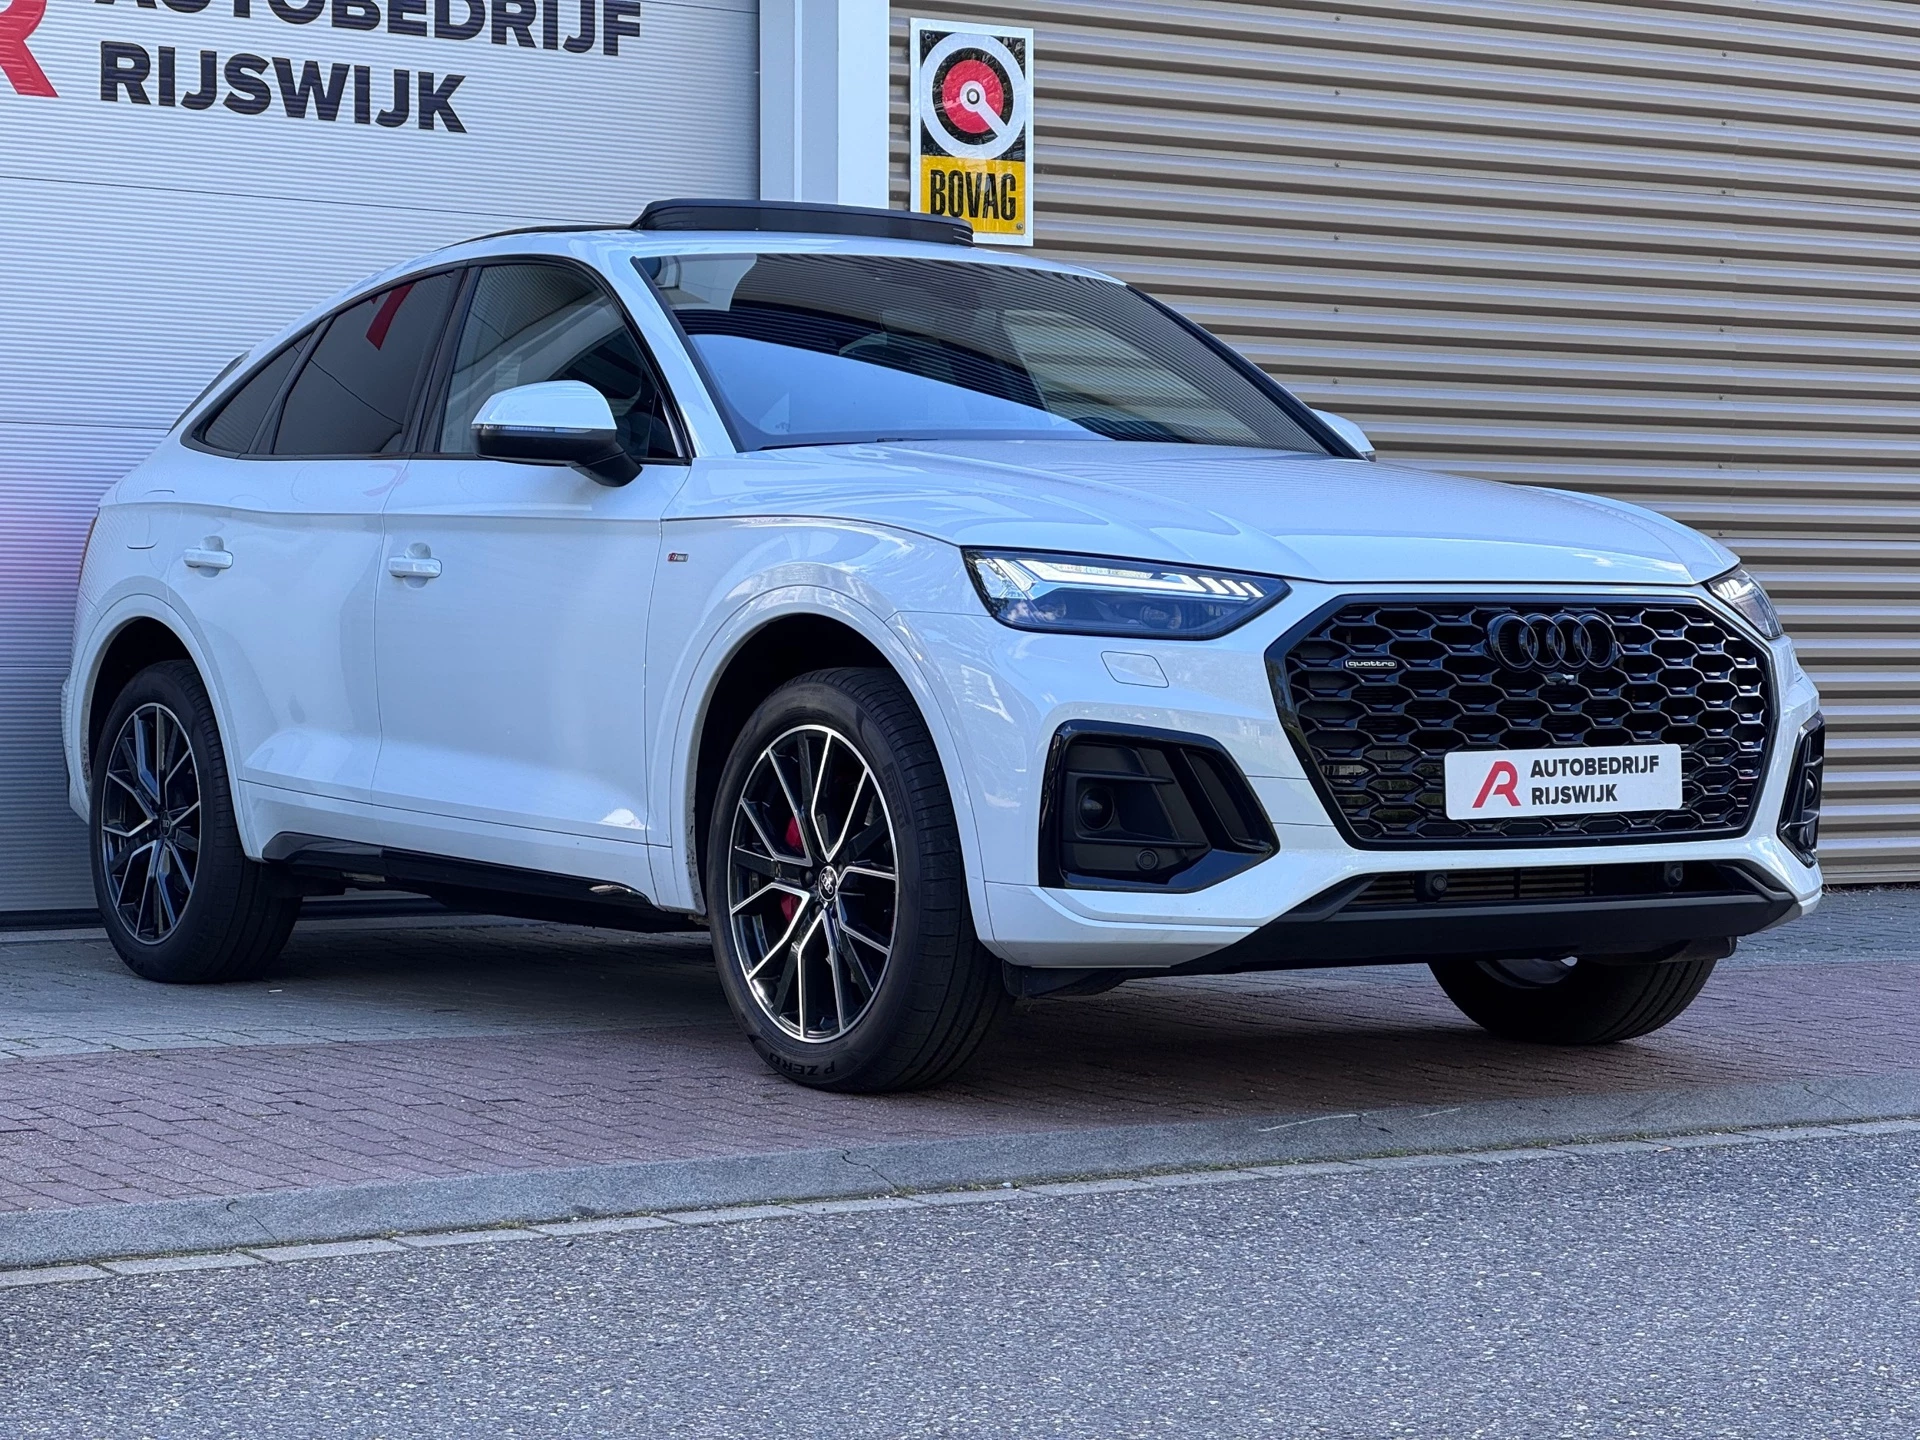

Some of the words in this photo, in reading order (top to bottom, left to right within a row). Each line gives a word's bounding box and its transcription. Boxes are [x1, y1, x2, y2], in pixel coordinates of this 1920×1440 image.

[94, 0, 641, 56] BEDRIJF
[100, 41, 467, 133] RIJSWIJK
[930, 169, 1016, 221] BOVAG
[1348, 660, 1395, 668] quattro
[1530, 755, 1660, 778] AUTOBEDRIJF
[1531, 784, 1618, 806] RIJSWIJK
[769, 1052, 819, 1076] ZERO
[824, 1061, 835, 1075] P
